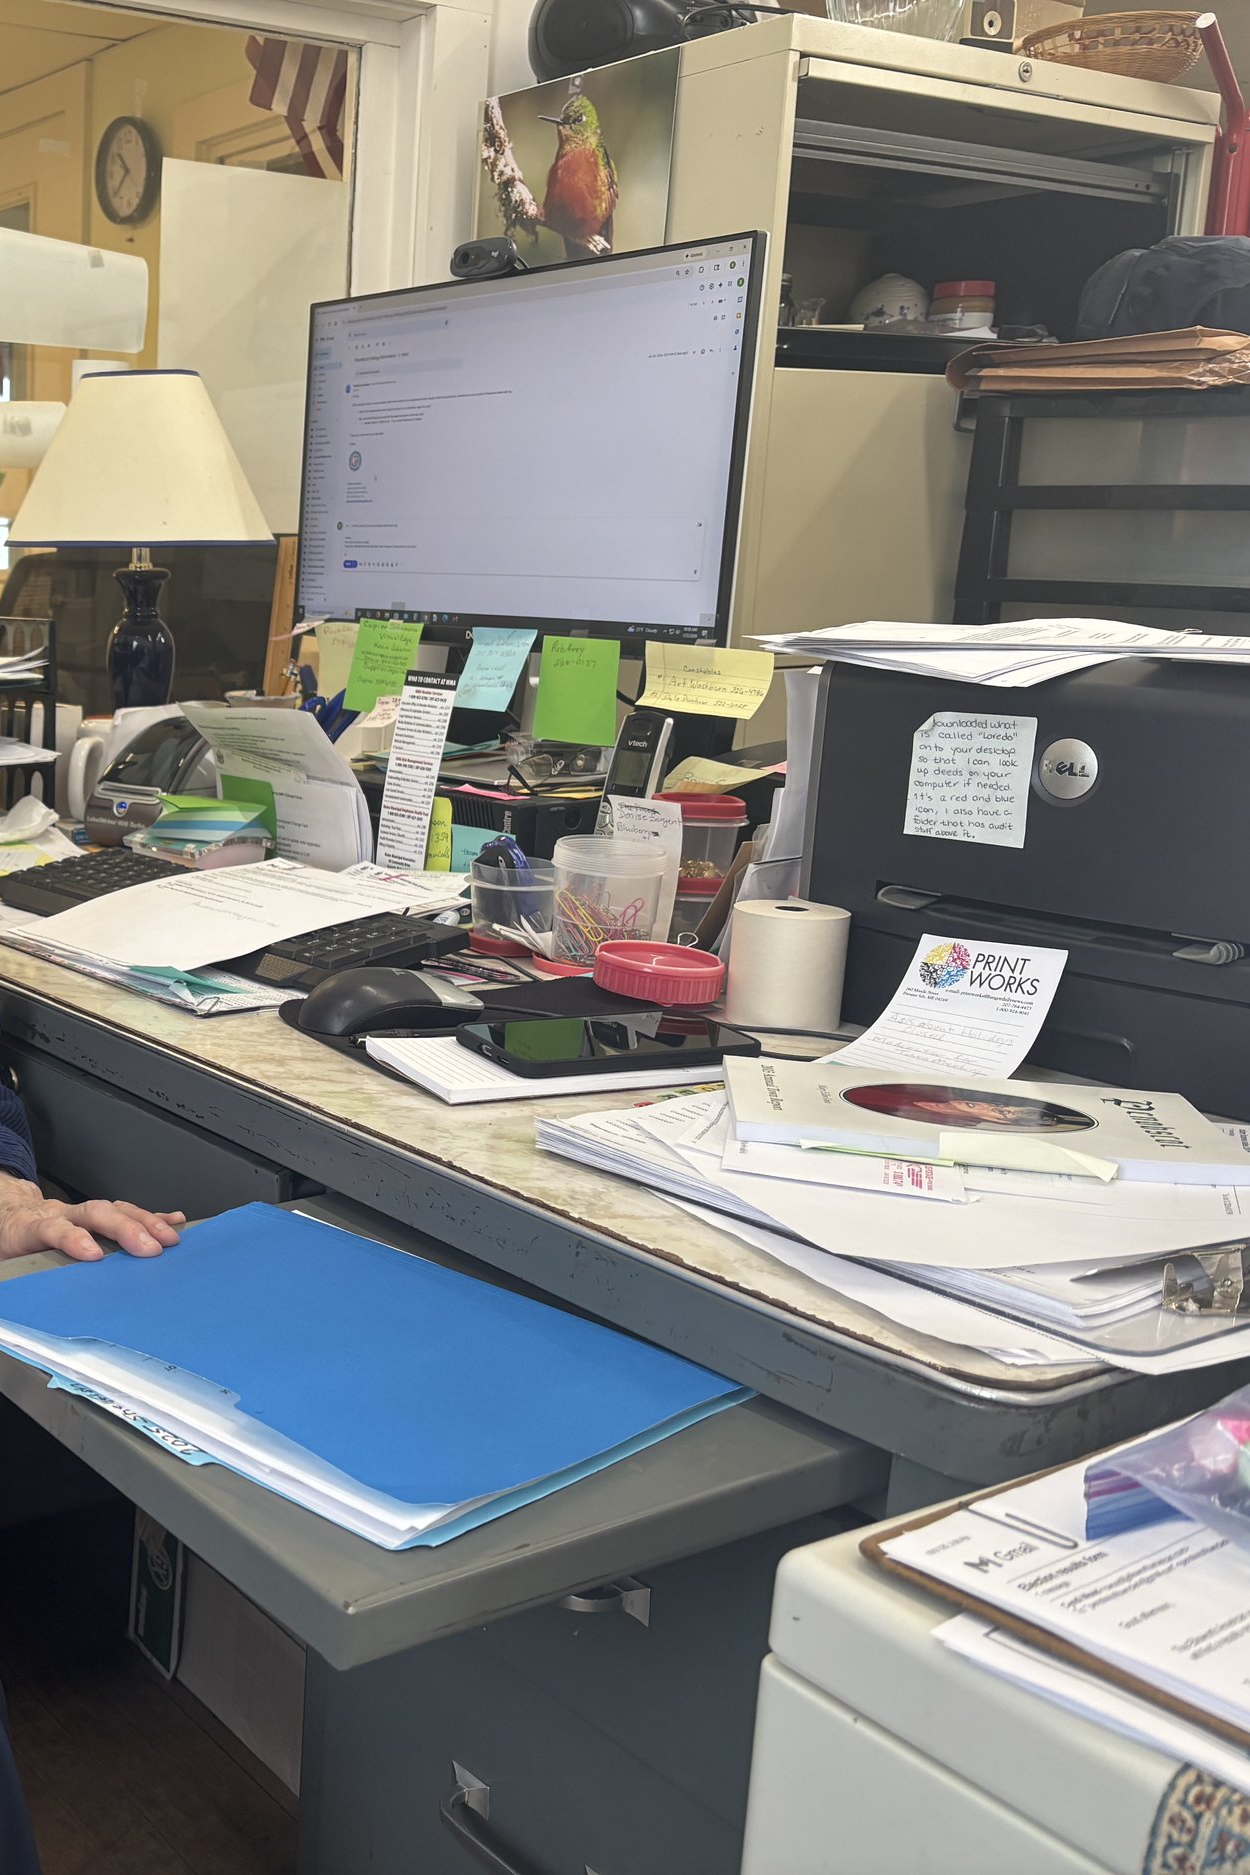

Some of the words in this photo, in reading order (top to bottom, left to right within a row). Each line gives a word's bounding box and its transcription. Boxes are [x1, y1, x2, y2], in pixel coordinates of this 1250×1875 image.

[990, 720, 1018, 729] what
[938, 731, 973, 740] called
[950, 747, 973, 756] your
[976, 746, 1016, 758] desktop
[934, 756, 956, 764] that
[999, 759, 1018, 767] look
[917, 767, 928, 777] up
[934, 767, 963, 776] deeds
[984, 771, 1012, 780] your
[914, 780, 960, 790] computer
[964, 778, 973, 788] if
[950, 792, 968, 802] red
[972, 793, 991, 802] and
[995, 794, 1015, 803] blue
[914, 804, 939, 815] icon,
[953, 807, 973, 816] also
[976, 806, 1001, 816] have
[1004, 808, 1012, 816] a
[940, 818, 964, 827] that
[968, 819, 985, 828] has
[988, 821, 1014, 831] audit
[935, 828, 958, 837] above
[972, 952, 1031, 975] PRINT
[969, 971, 1040, 996] WORKS
